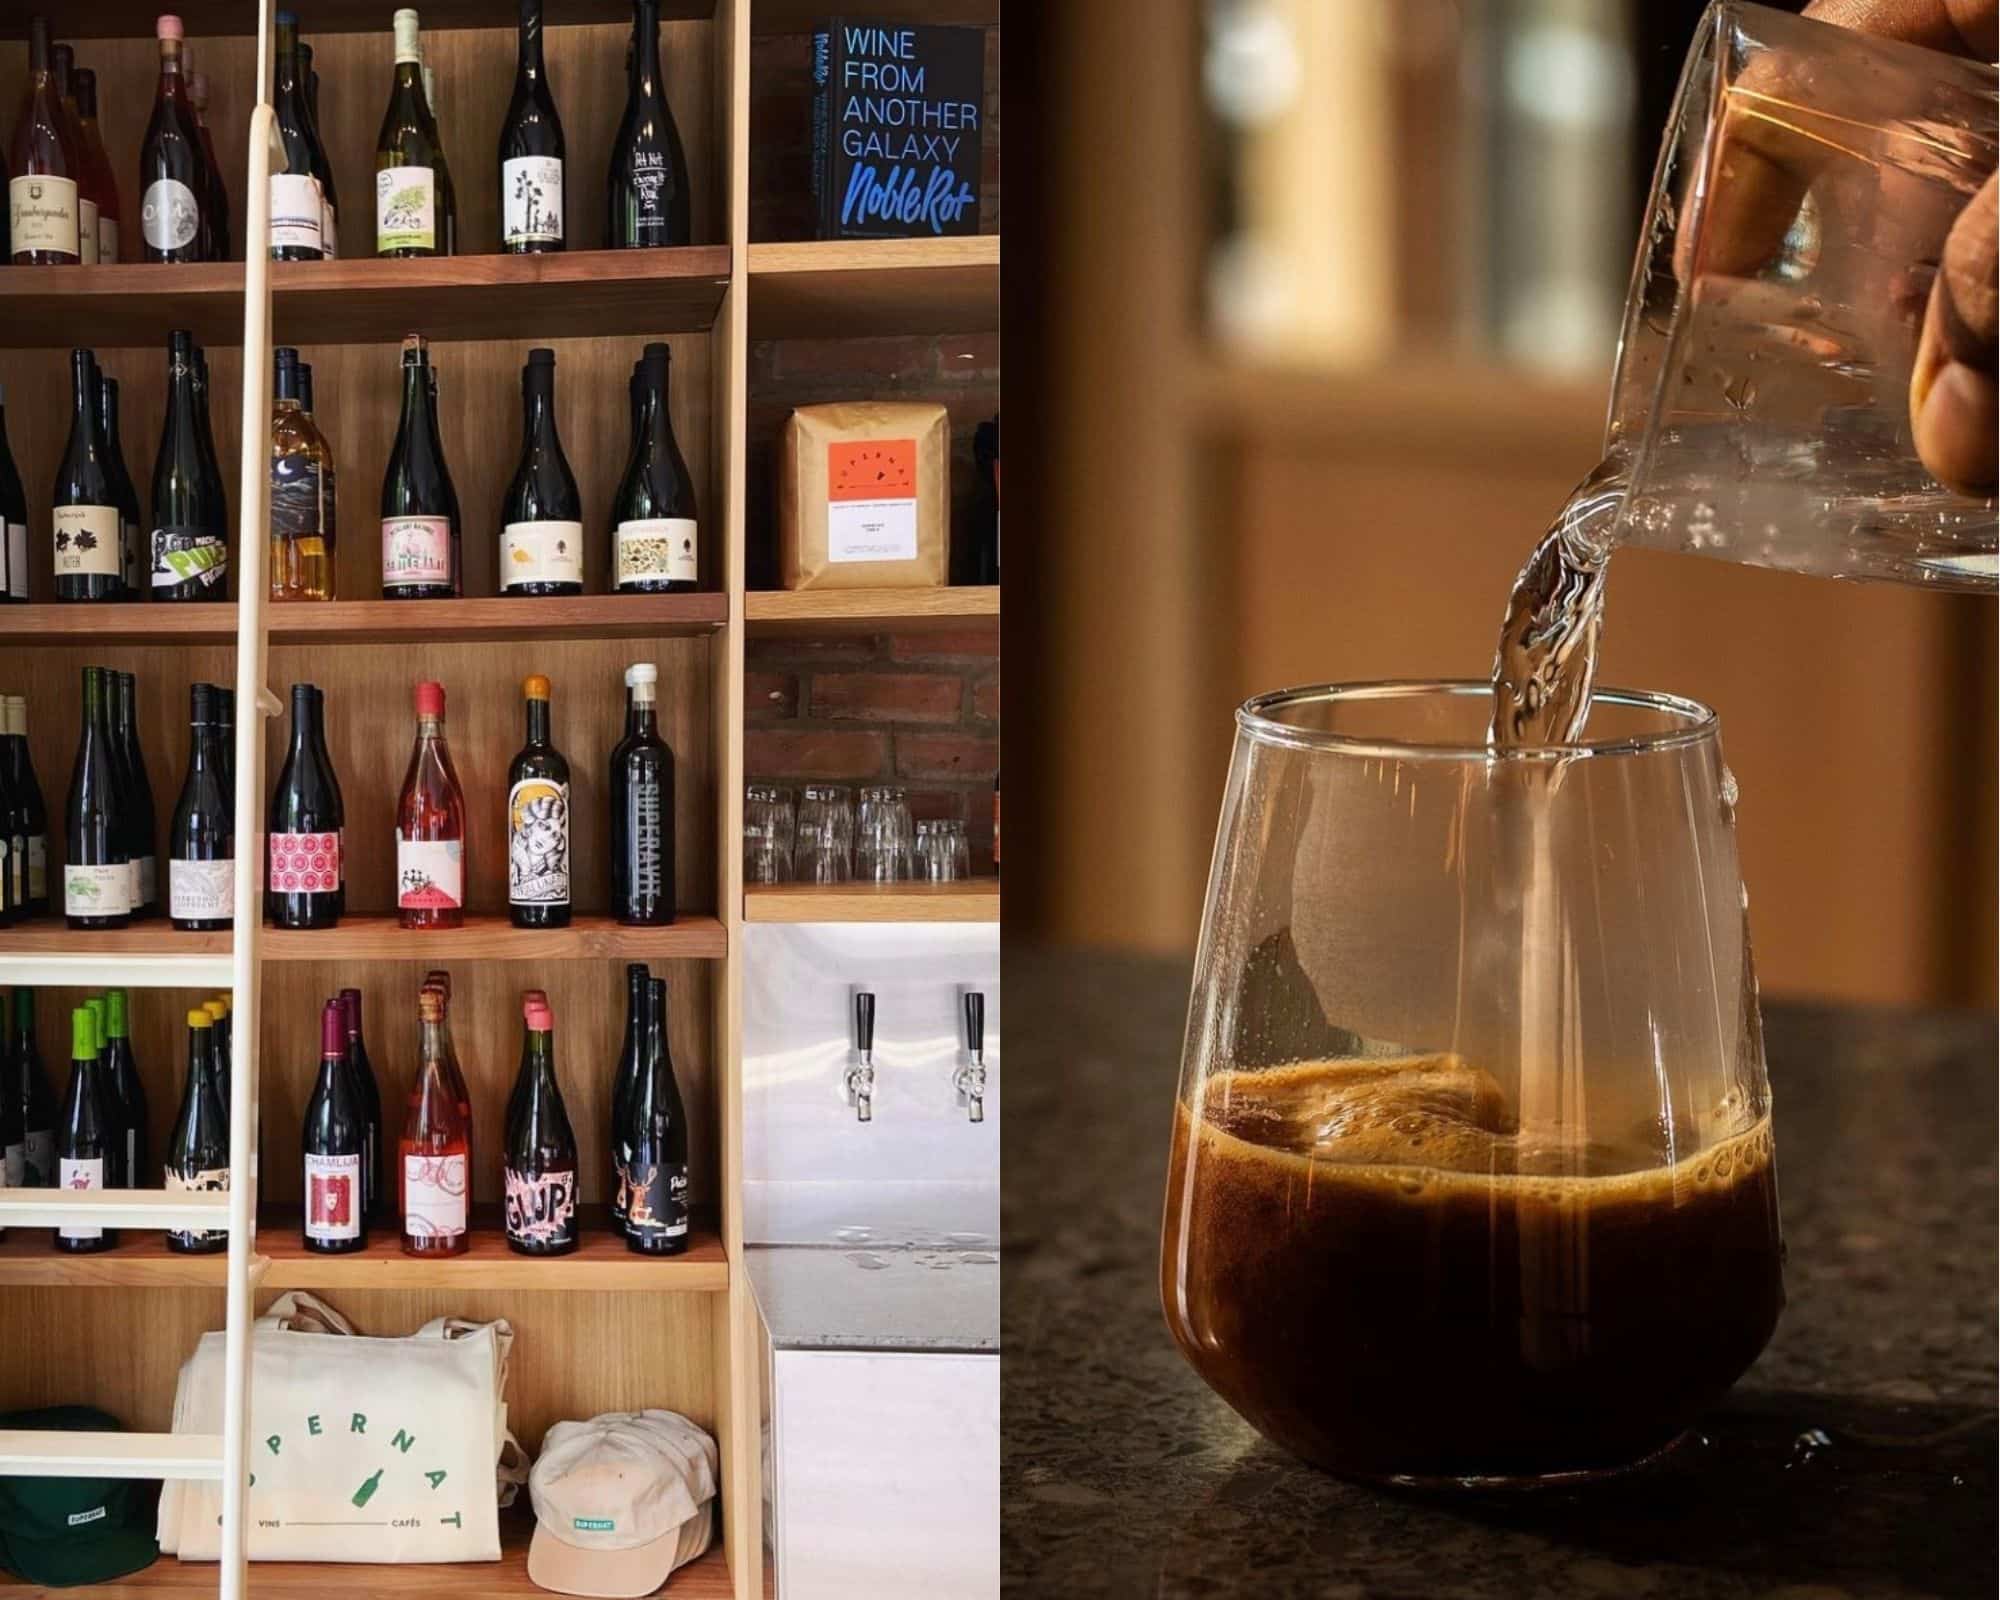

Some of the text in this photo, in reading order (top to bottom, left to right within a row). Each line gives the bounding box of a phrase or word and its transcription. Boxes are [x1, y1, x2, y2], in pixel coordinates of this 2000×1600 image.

[845, 26, 916, 60] WINE
[844, 61, 925, 93] FROM
[843, 95, 978, 130] ANOTHER
[842, 129, 960, 163] GALAXY
[217, 1412, 462, 1529] PERNAT
[258, 1519, 281, 1529] VINS
